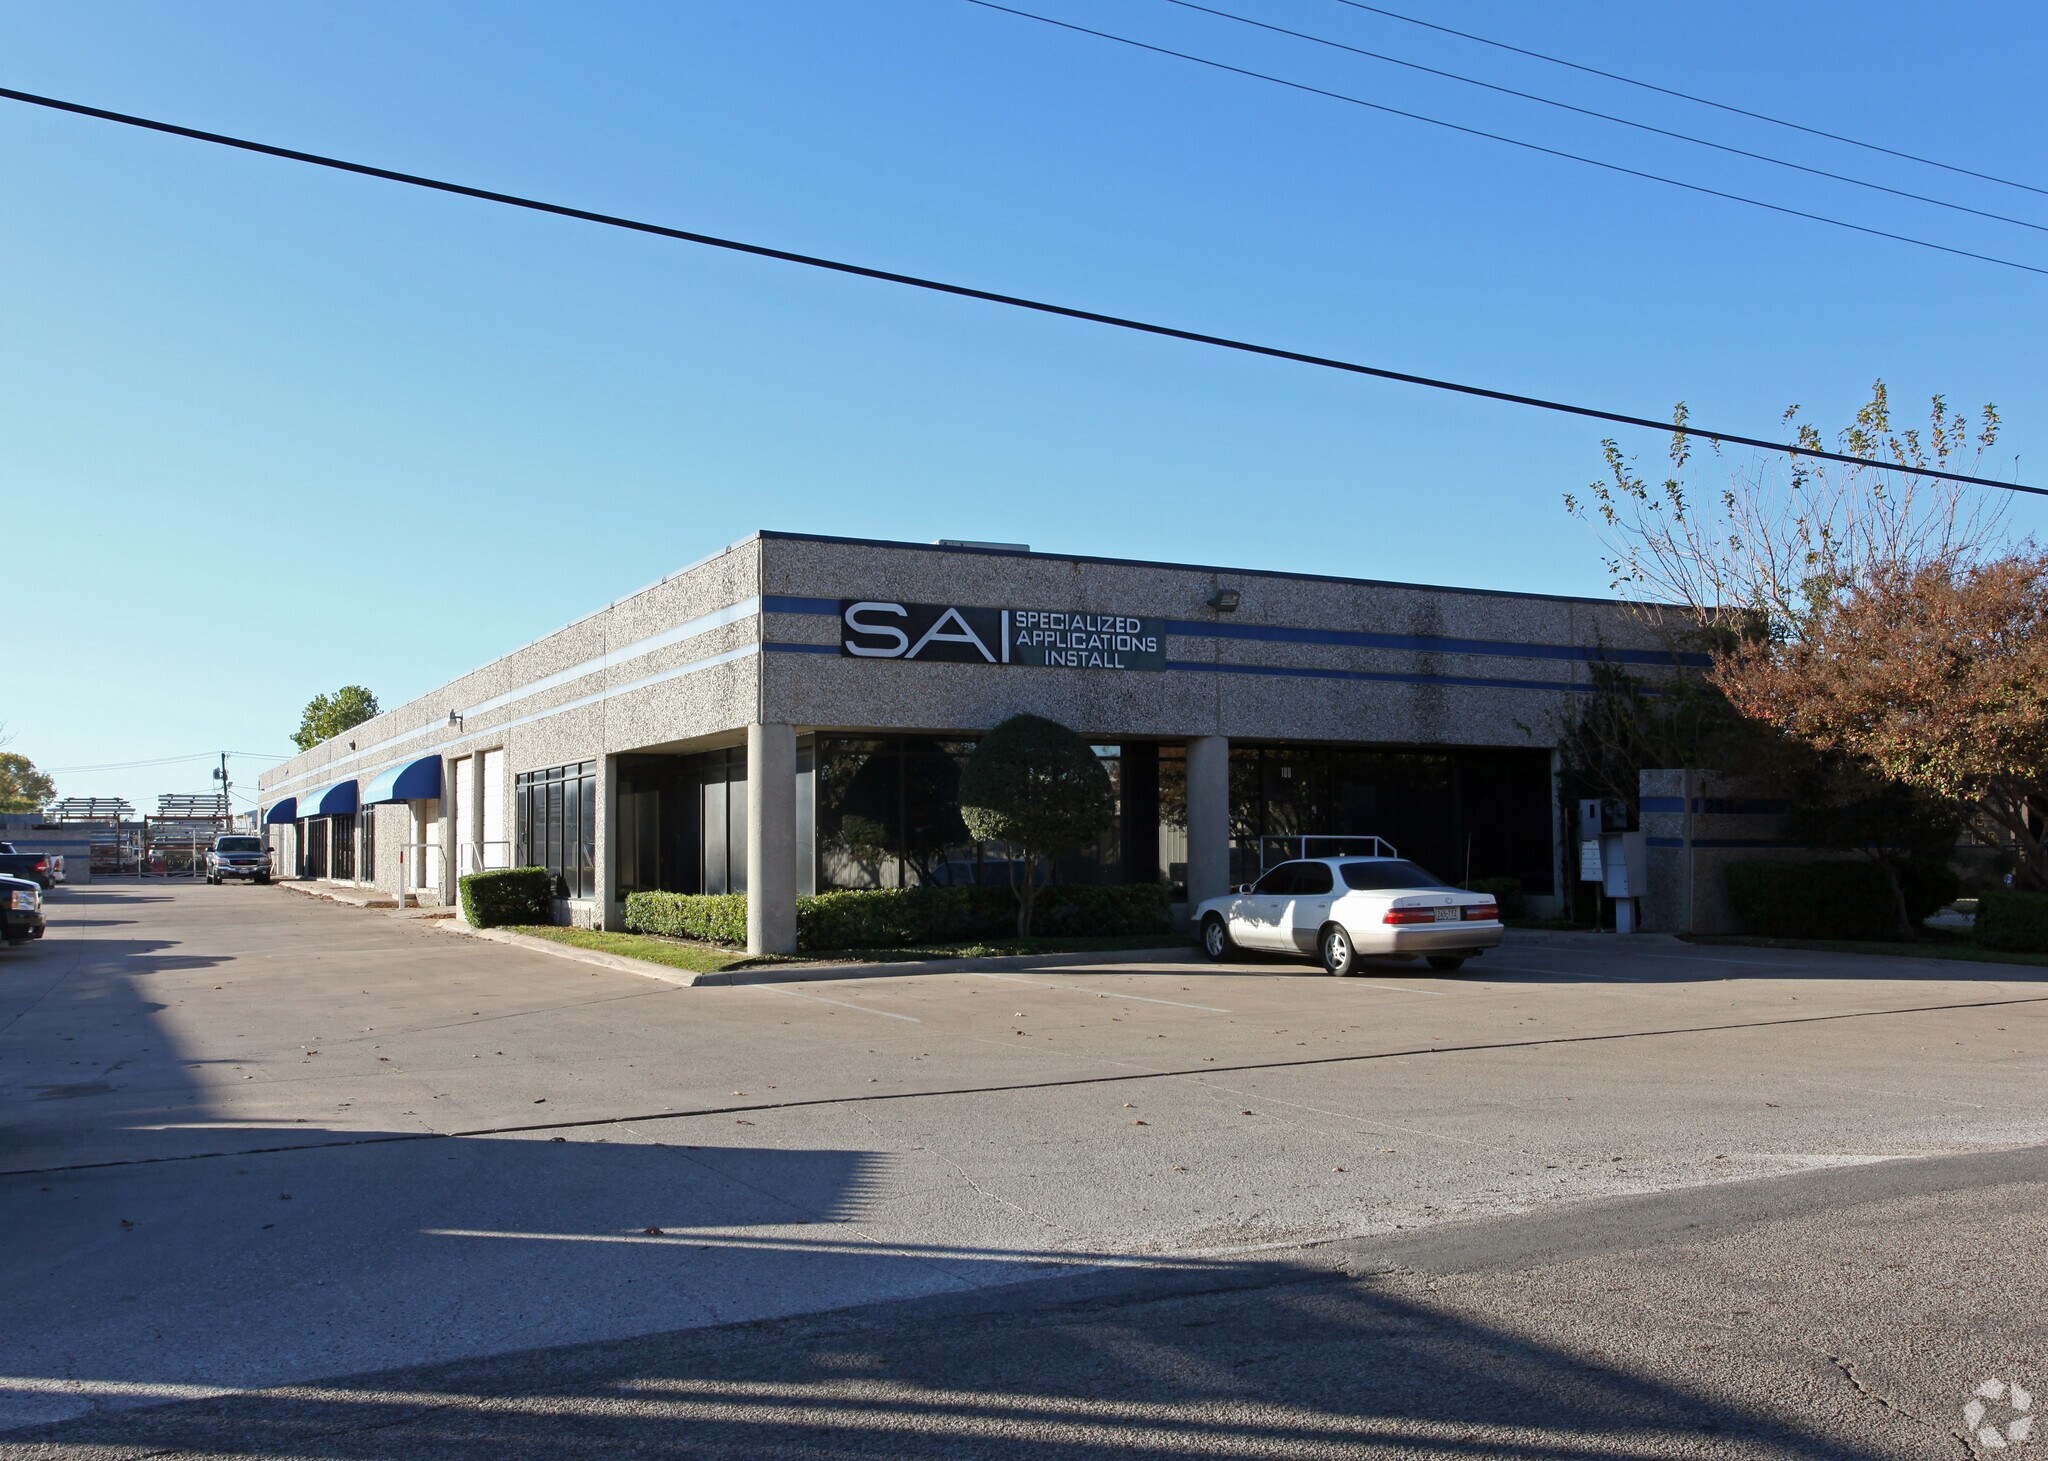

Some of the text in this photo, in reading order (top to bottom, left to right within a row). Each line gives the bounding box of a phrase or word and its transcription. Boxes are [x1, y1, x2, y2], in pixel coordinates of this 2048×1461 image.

[1016, 611, 1141, 633] SPECIALIZED
[1016, 630, 1157, 652] APPLICATIONS
[1045, 650, 1125, 669] INSTALL
